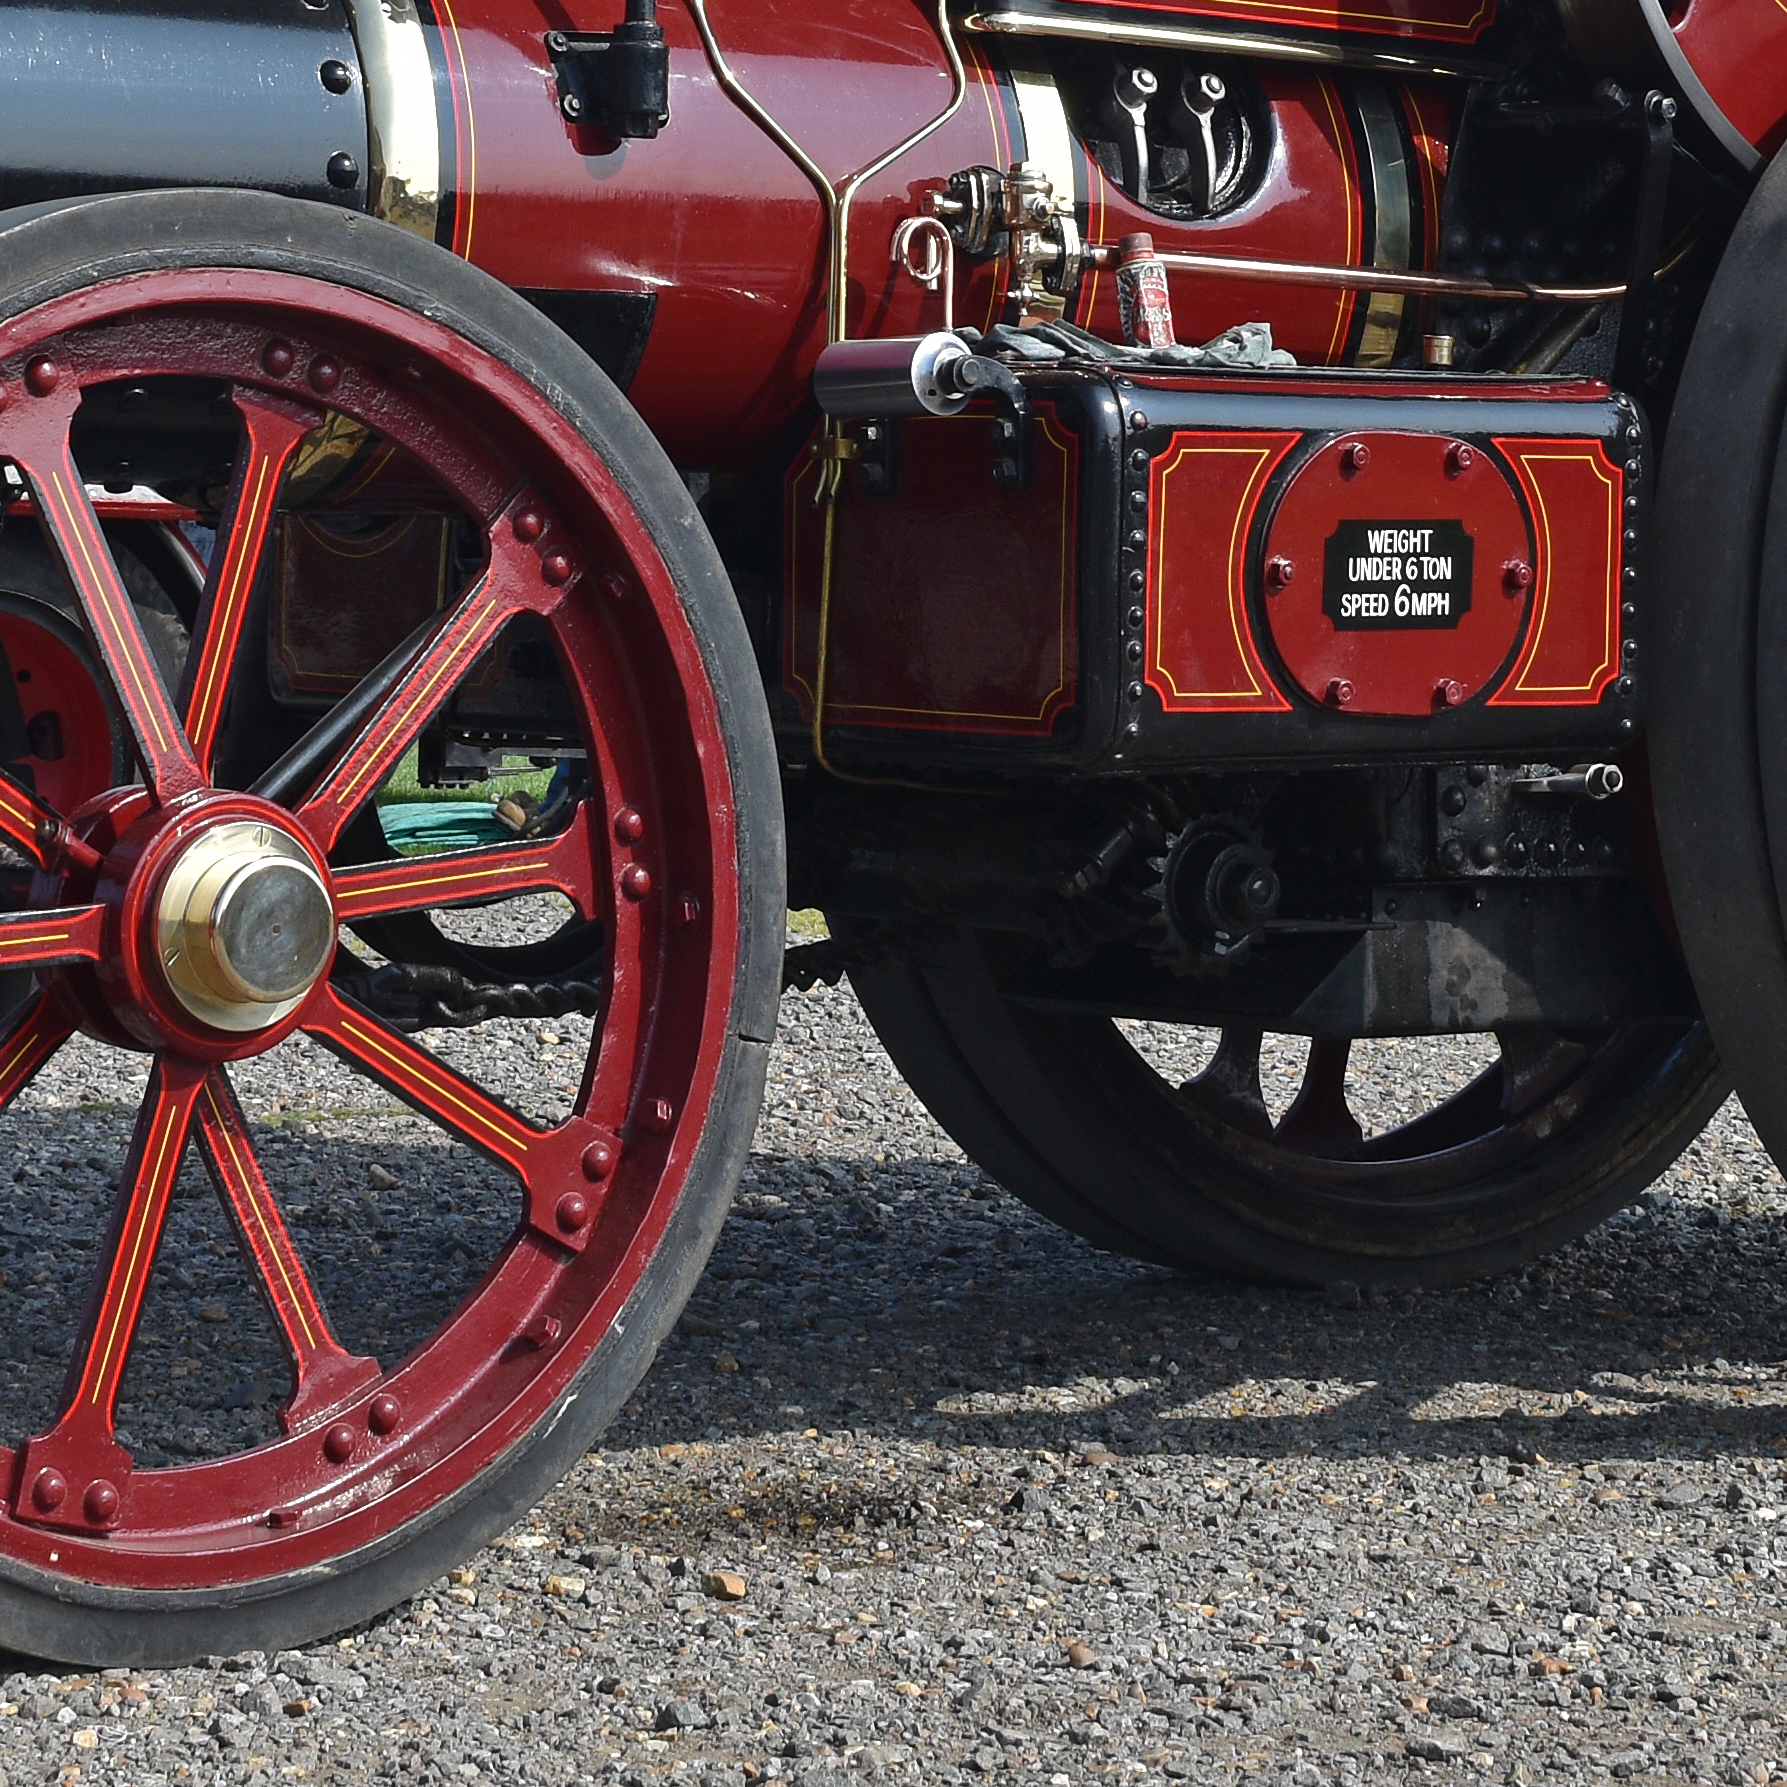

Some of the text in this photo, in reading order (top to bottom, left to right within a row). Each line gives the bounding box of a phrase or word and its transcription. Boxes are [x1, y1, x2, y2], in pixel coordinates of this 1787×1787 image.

[1367, 529, 1434, 554] WEIGHT
[1348, 556, 1452, 582] UNDER 6 TON
[1340, 584, 1450, 617] SPEED 6 MPH
